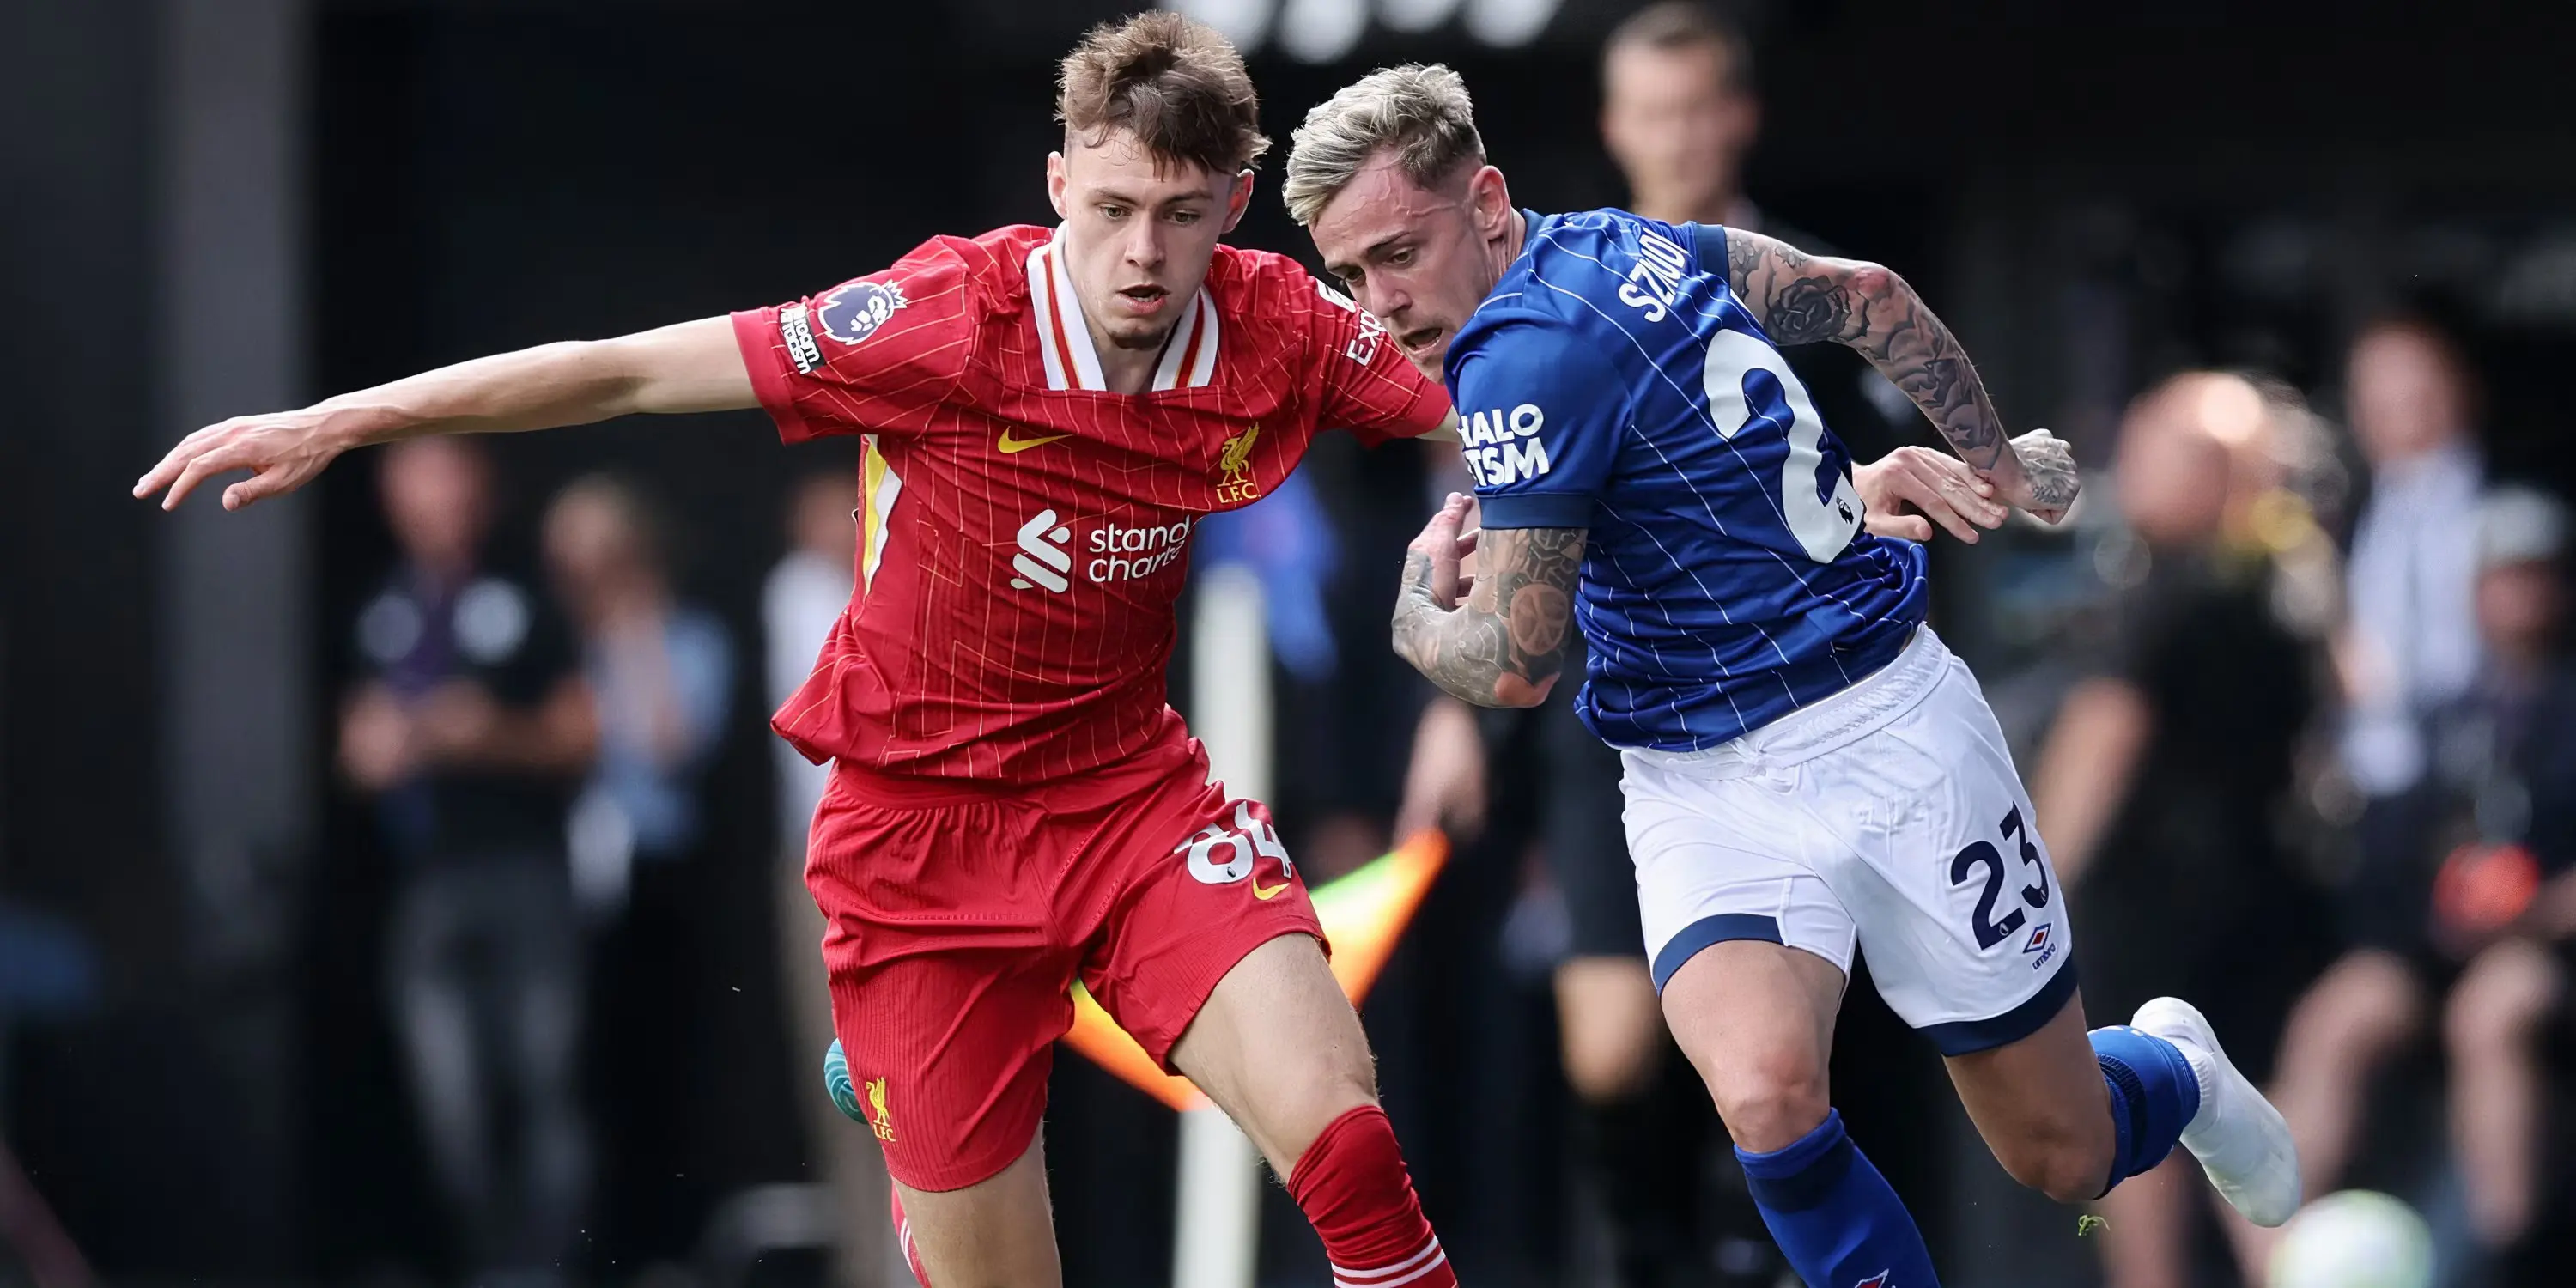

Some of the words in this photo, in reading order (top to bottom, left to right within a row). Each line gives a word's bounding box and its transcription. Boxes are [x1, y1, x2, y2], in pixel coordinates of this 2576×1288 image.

[1462, 437, 1550, 487] TSM
[1174, 800, 1292, 884] 84
[1950, 800, 2050, 951] 23
[2032, 943, 2057, 971] umbro
